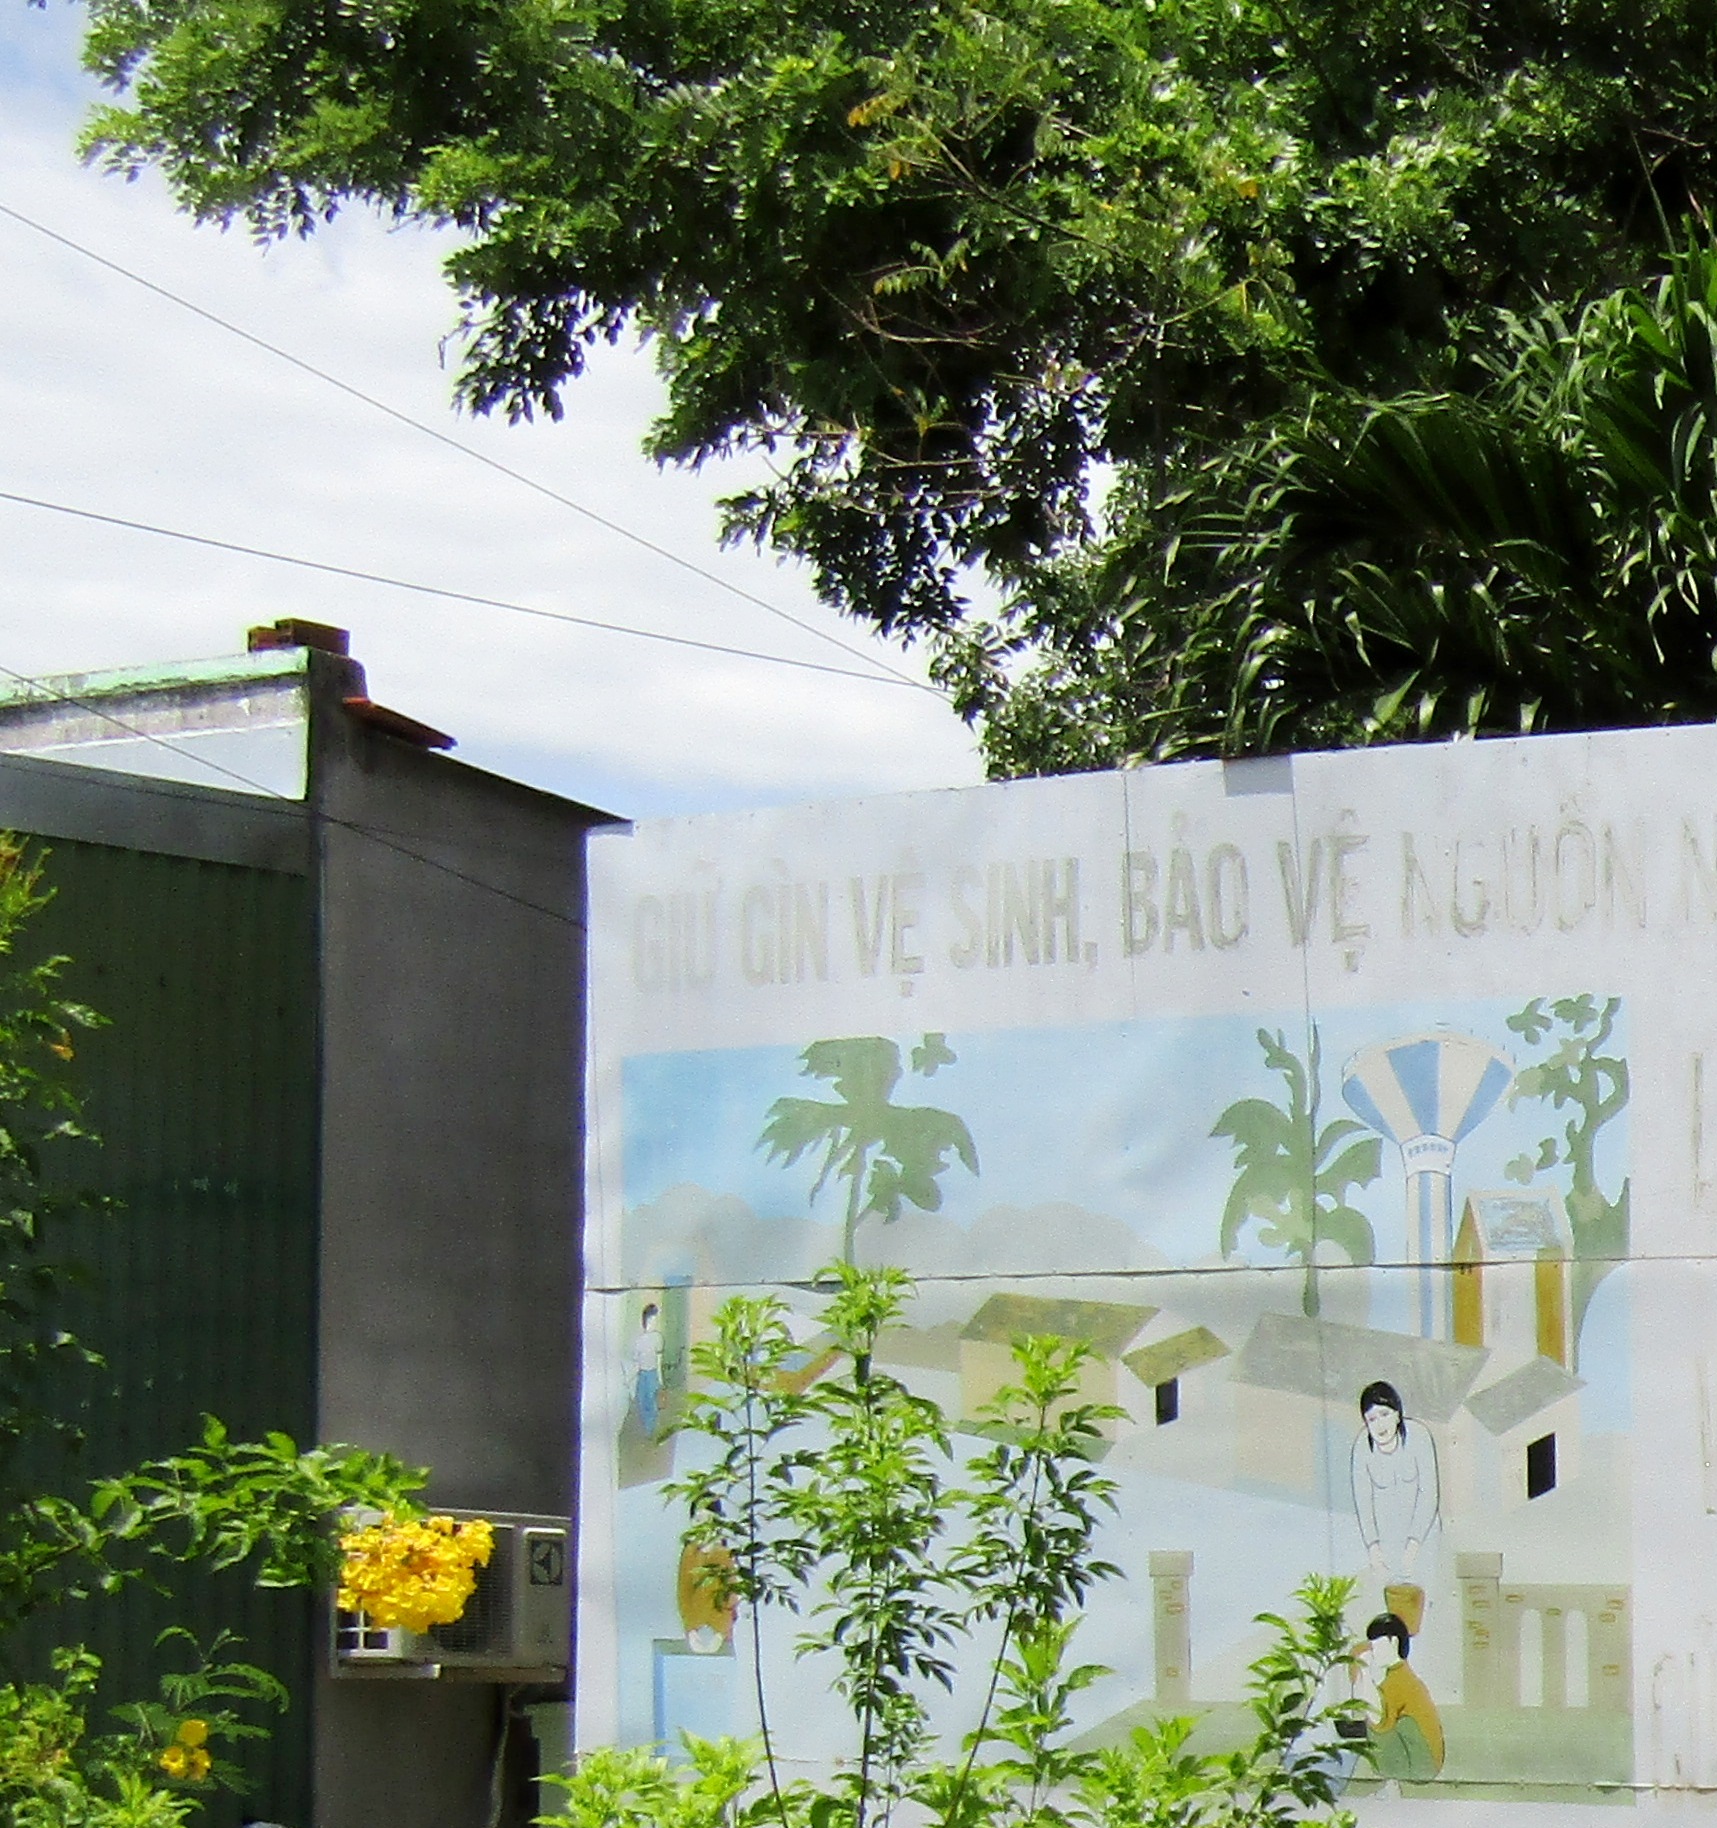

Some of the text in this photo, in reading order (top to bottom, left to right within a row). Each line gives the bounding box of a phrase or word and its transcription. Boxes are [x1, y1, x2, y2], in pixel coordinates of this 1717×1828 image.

[741, 856, 829, 988] GÌN
[848, 846, 924, 999] VỆ
[949, 856, 1099, 972] SINH,
[1121, 809, 1251, 959] BẢO
[1275, 806, 1370, 975] VỆ
[1400, 795, 1649, 941] NGUỒN
